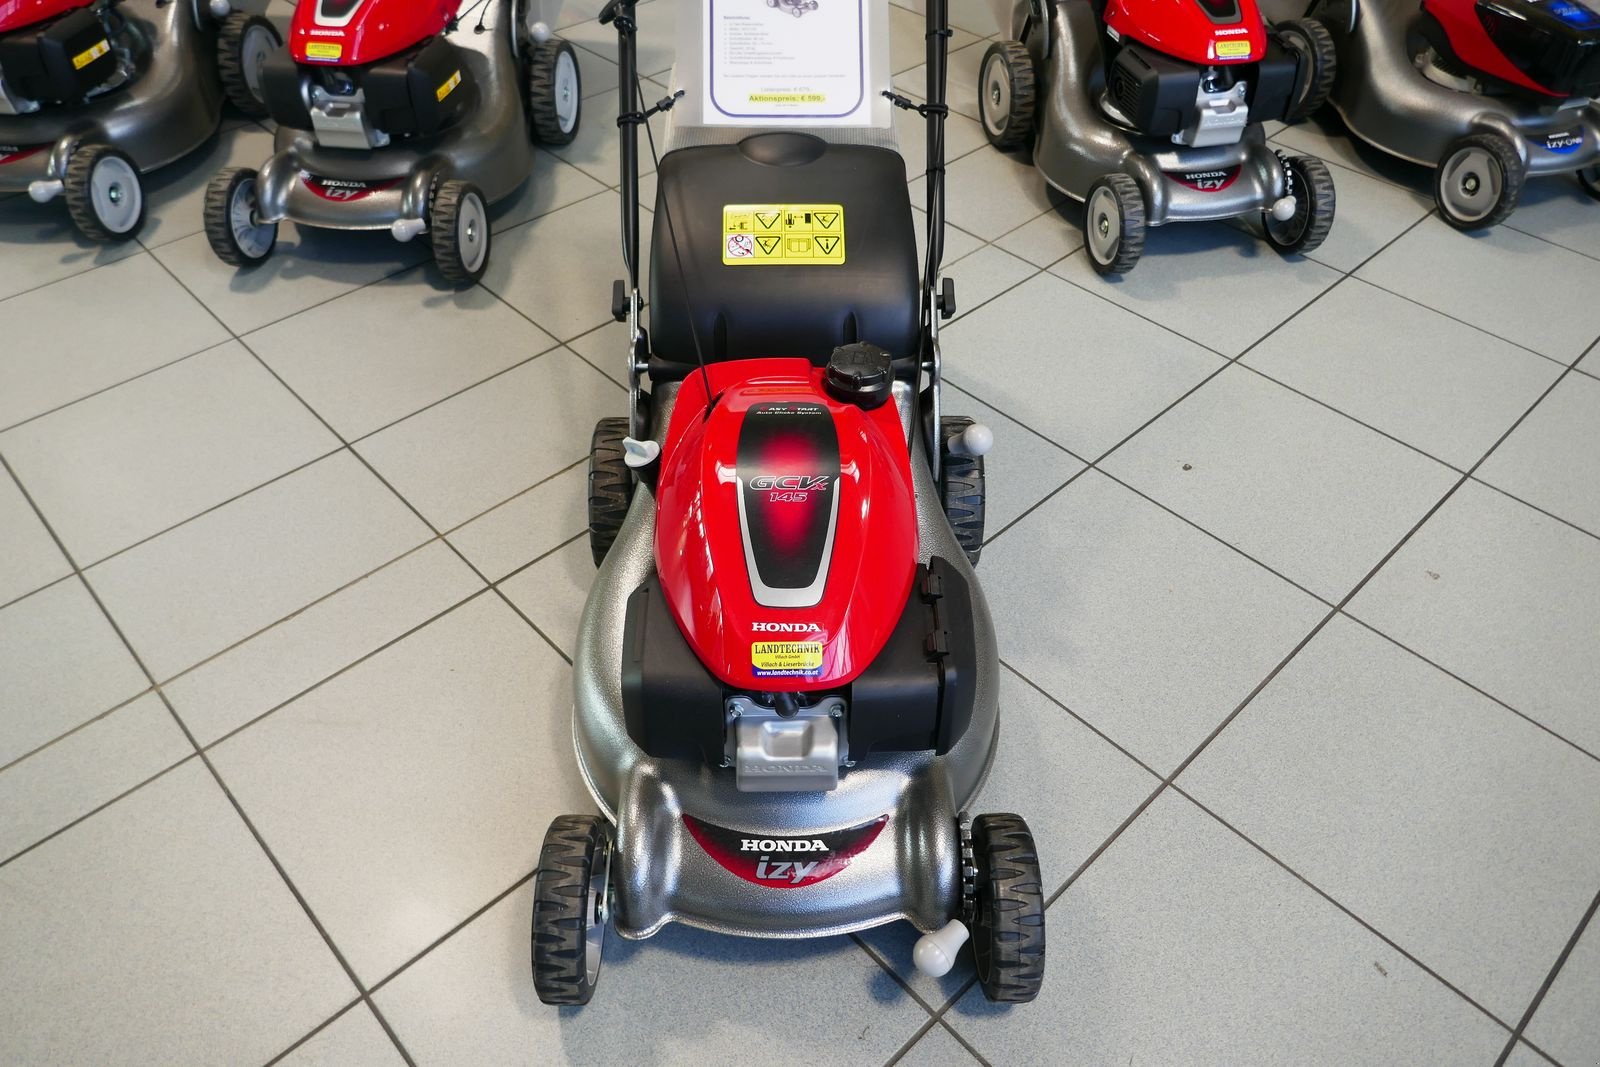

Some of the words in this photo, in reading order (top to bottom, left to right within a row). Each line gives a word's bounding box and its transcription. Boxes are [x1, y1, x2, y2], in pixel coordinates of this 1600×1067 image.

[1185, 171, 1227, 180] HONDA
[322, 179, 367, 188] HONDA
[1197, 179, 1224, 190] izy
[325, 187, 359, 200] izy
[769, 492, 808, 502] 145
[752, 622, 822, 632] HONDA
[755, 644, 820, 653] LANDTECHNIK
[740, 839, 829, 852] HONDA
[755, 855, 819, 884] izy
